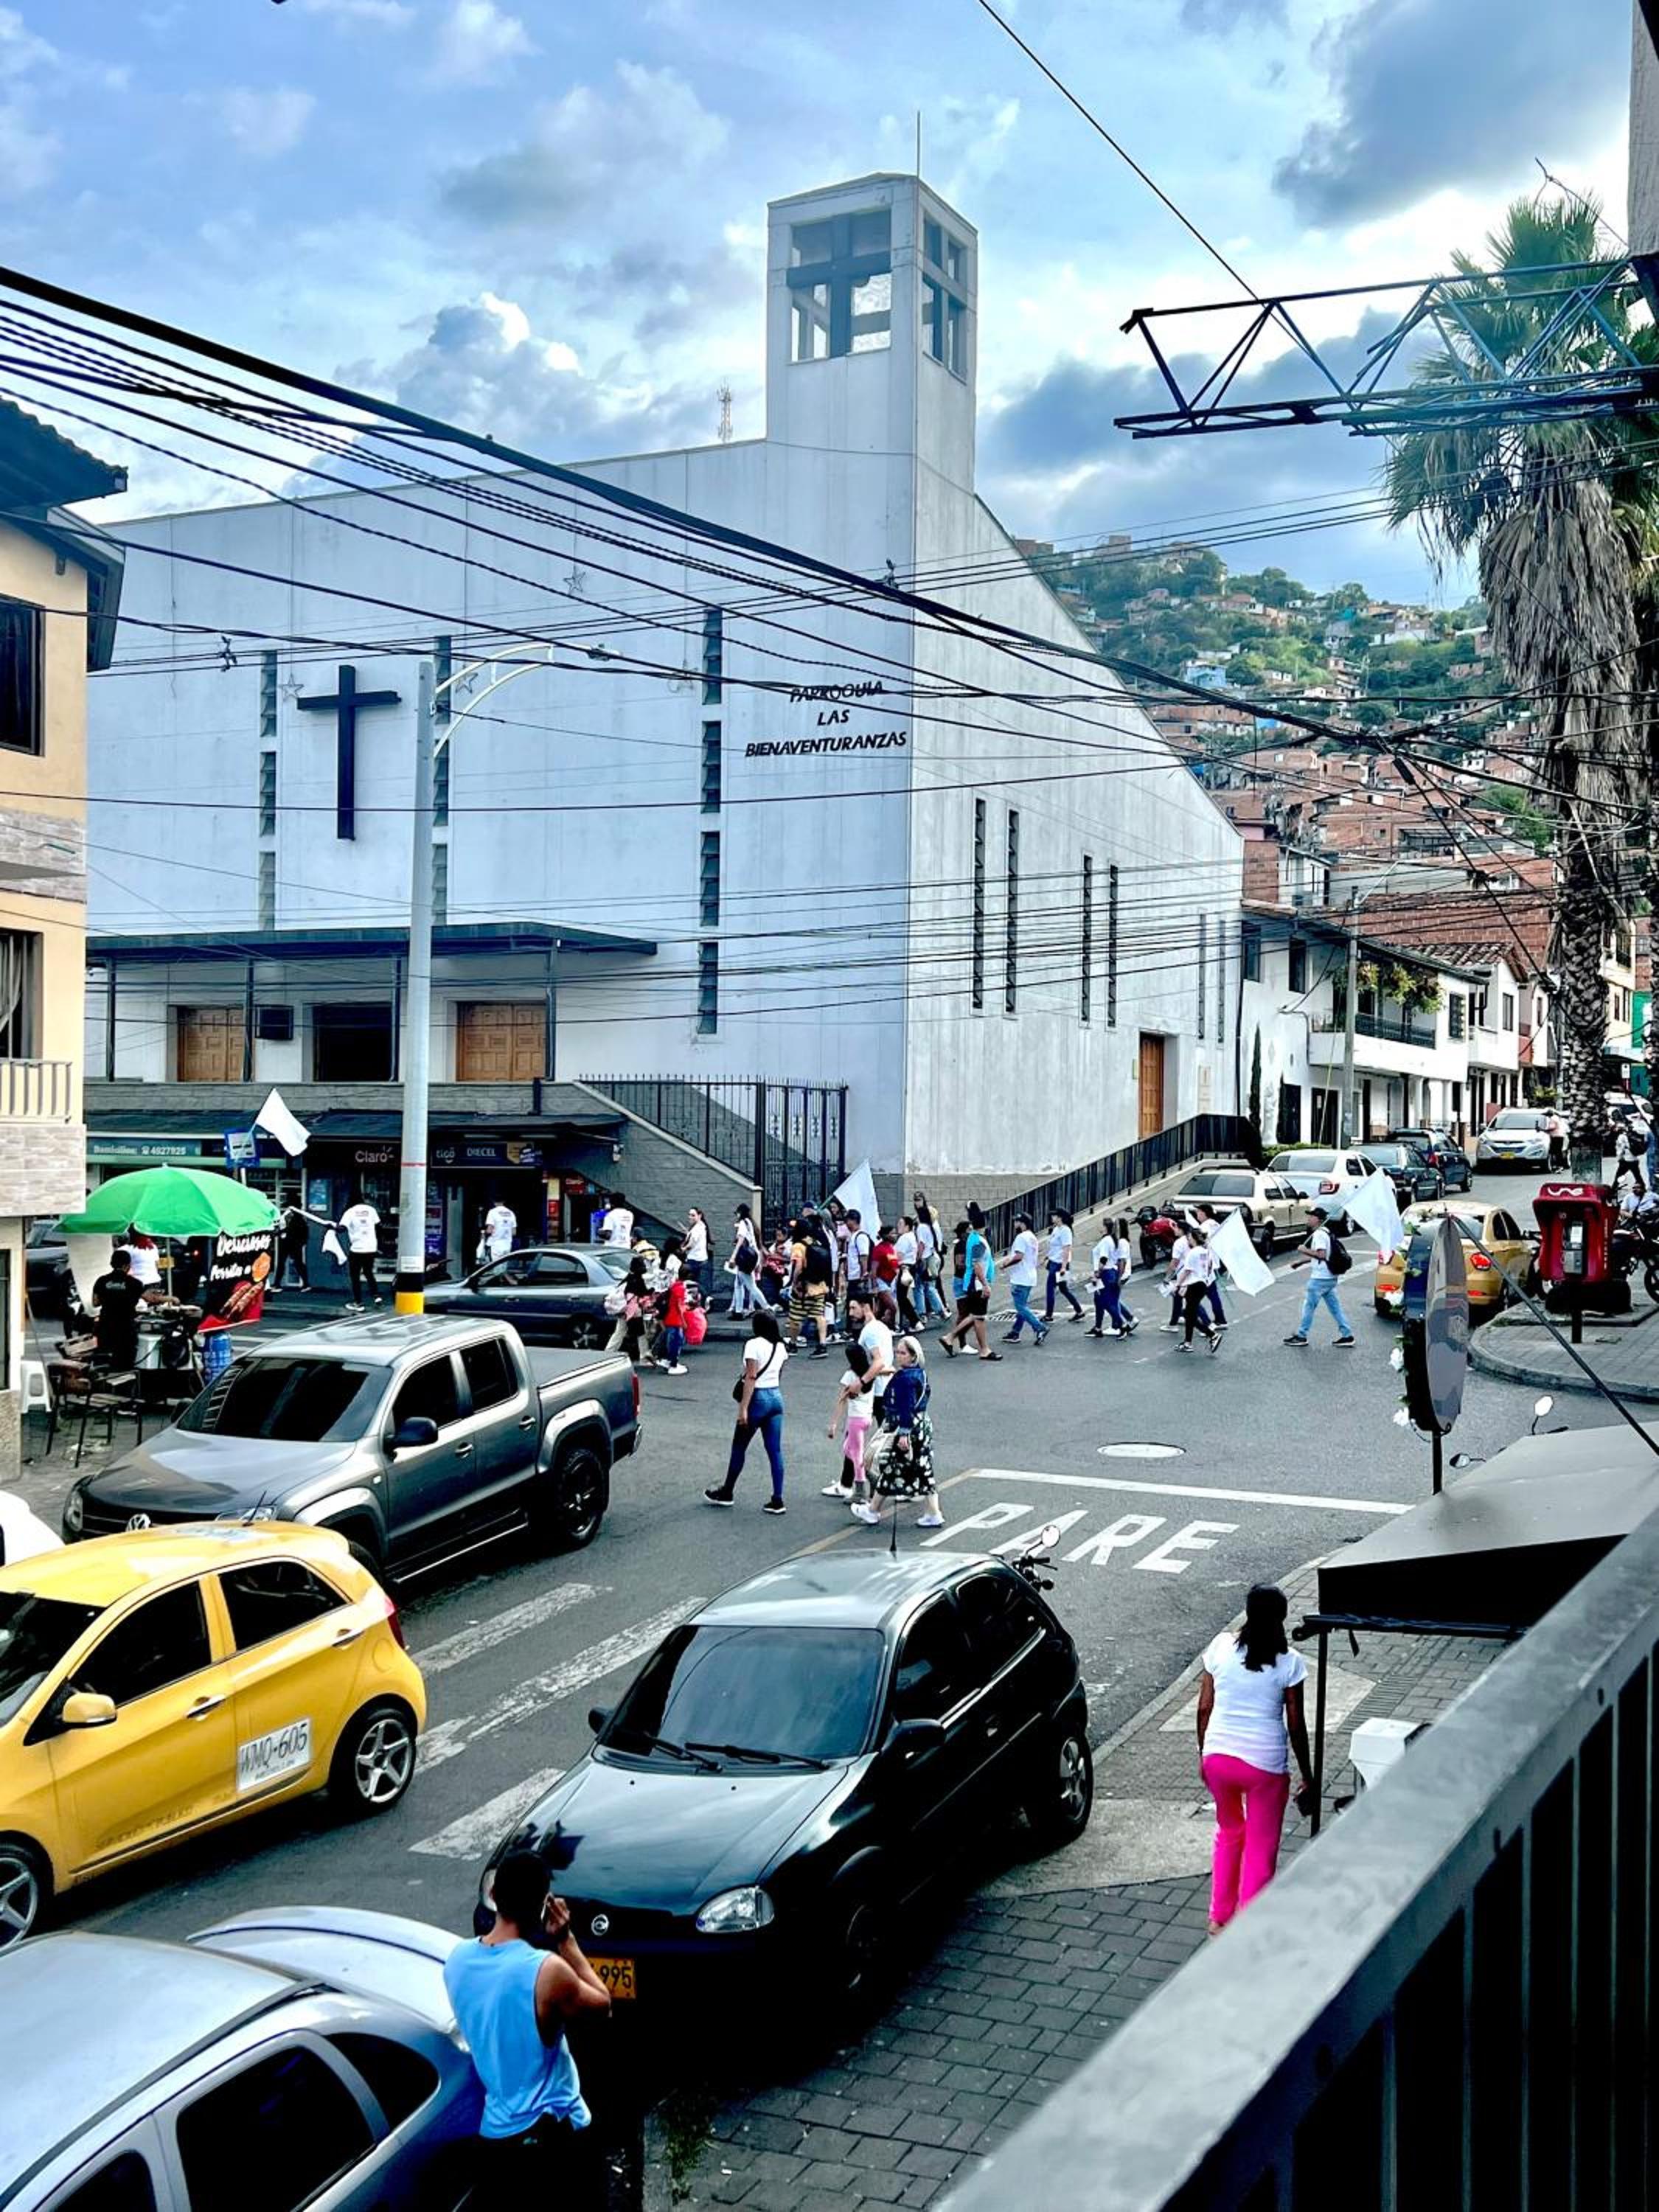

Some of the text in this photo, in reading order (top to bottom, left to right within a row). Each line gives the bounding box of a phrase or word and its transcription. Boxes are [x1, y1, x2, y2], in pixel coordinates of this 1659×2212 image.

[817, 709, 850, 726] LAS
[745, 731, 908, 757] BIENAVENTURANZAS
[355, 1150, 388, 1164] Claro
[919, 1502, 1240, 1574] PARE
